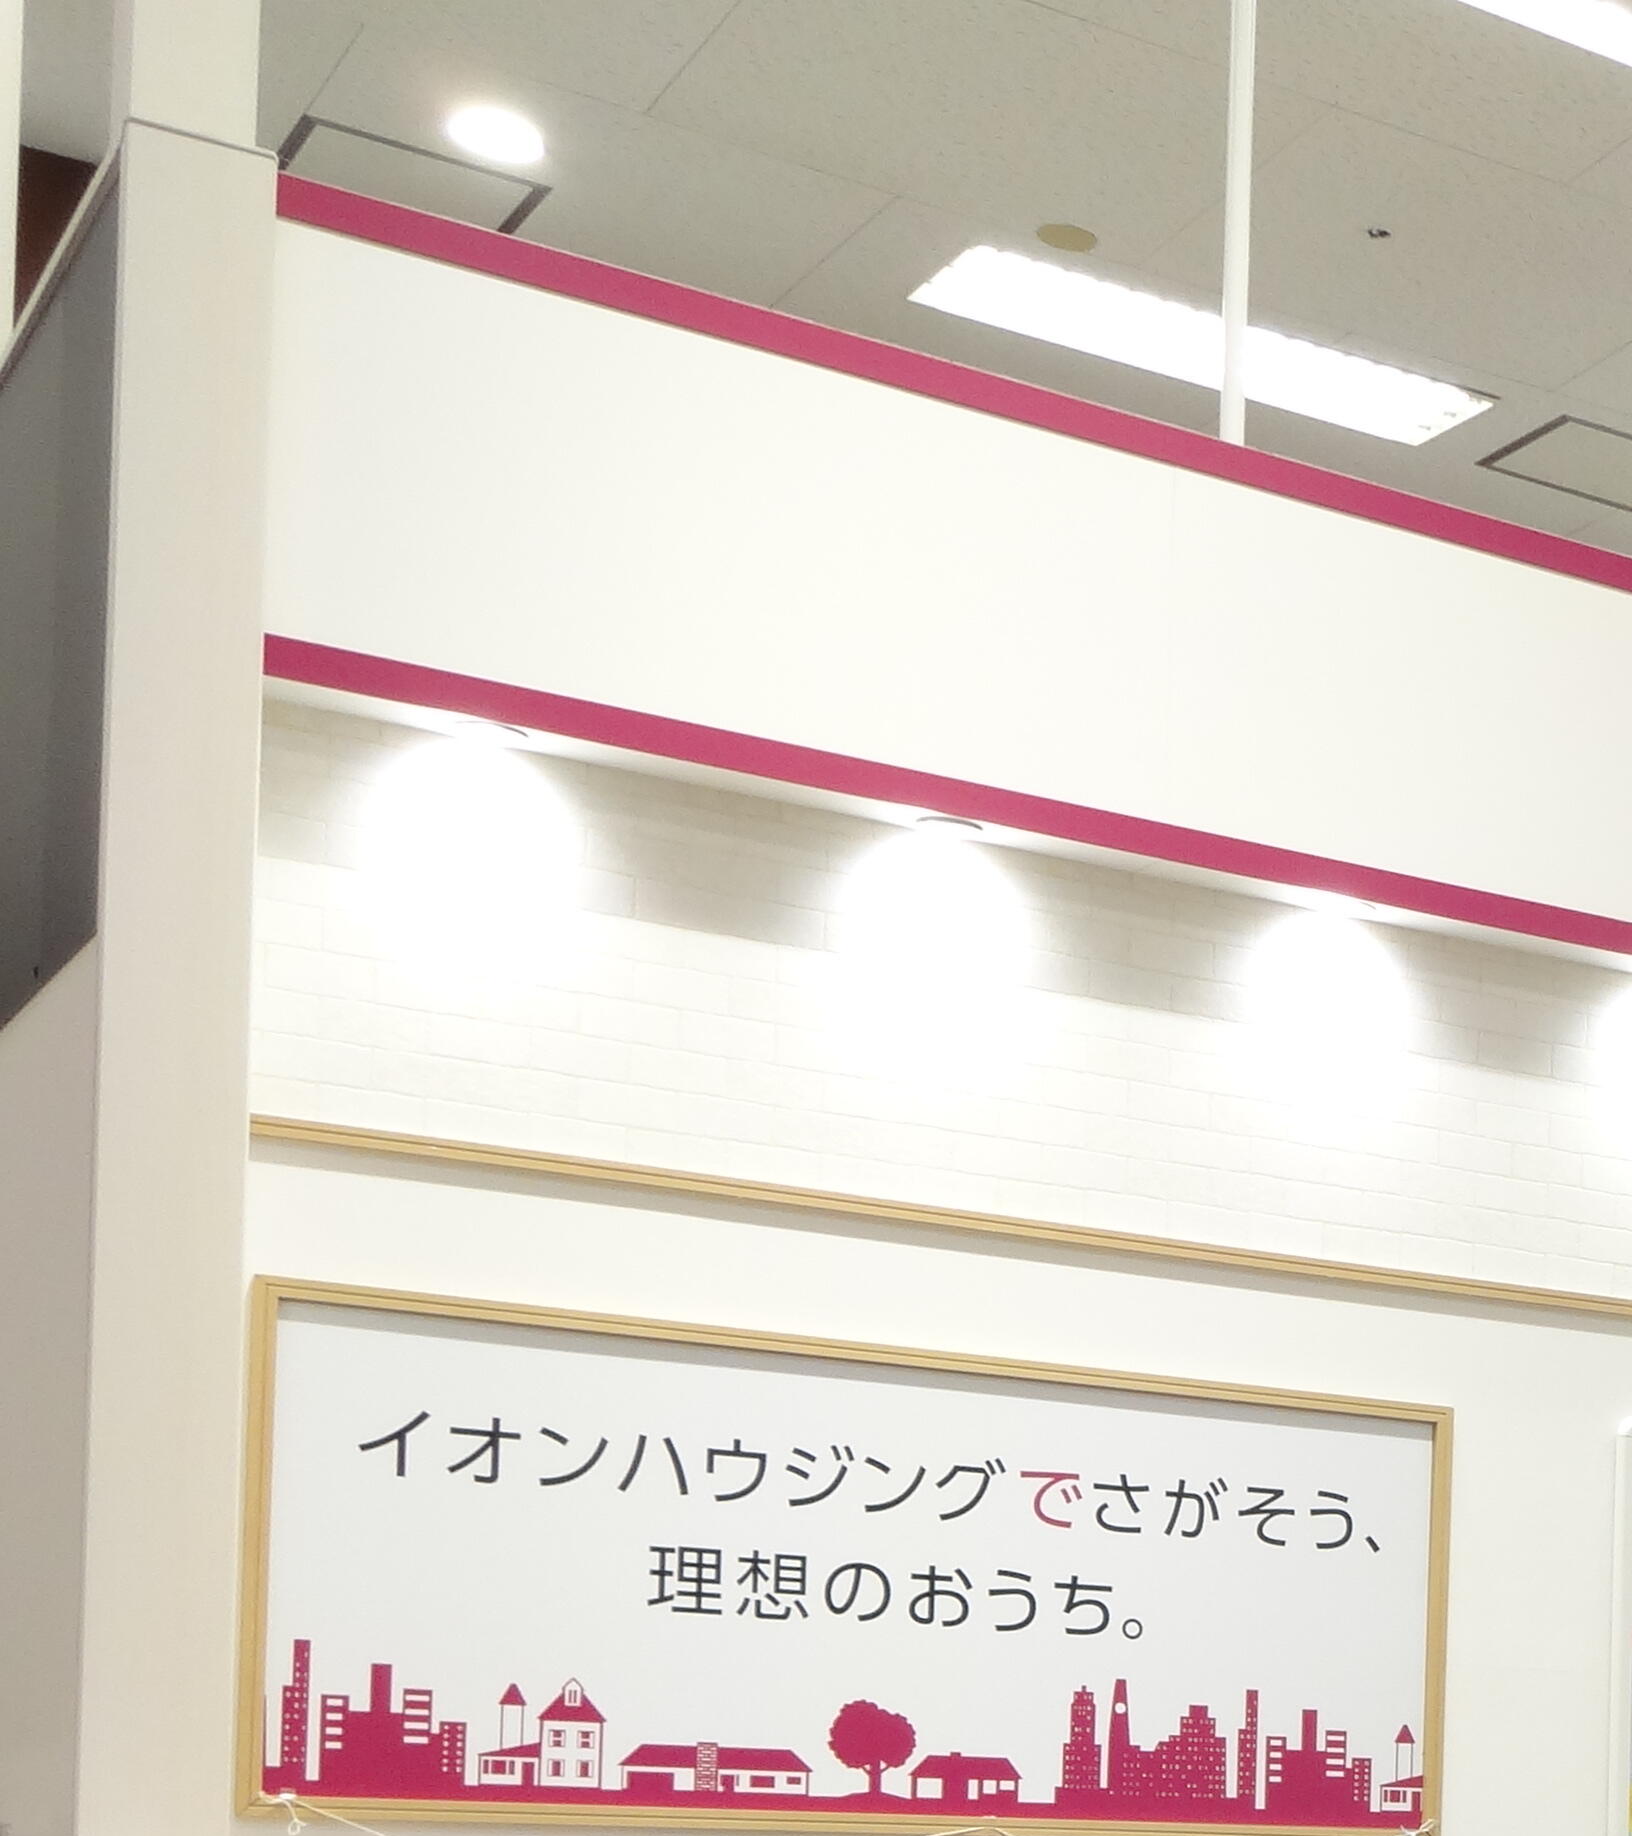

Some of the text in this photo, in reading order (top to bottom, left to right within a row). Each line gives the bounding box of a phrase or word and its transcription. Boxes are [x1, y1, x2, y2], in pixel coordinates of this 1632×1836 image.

[357, 1409, 1382, 1553] イオンハウジングでさがそう、
[647, 1543, 1145, 1641] 理想のおうち。
